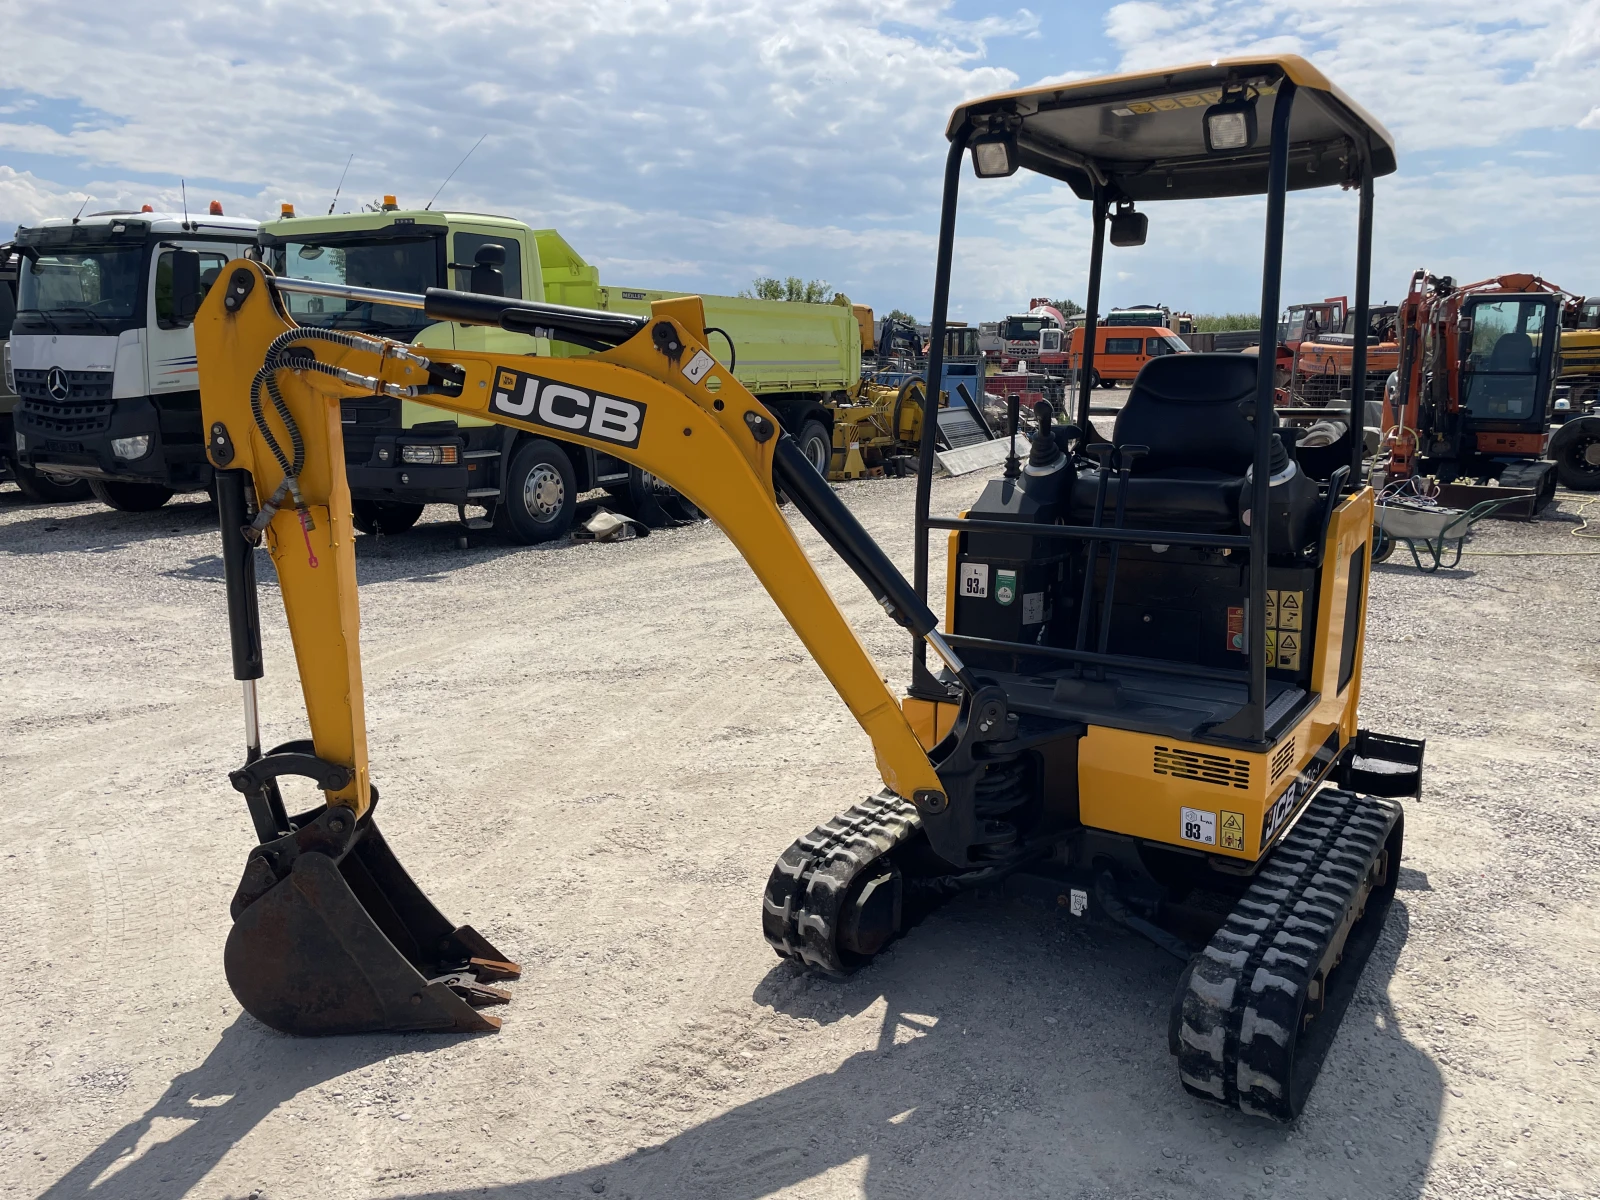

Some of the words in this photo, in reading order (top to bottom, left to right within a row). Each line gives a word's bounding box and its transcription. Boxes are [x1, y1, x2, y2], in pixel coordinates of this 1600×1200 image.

[495, 378, 641, 442] JCB
[966, 577, 980, 594] 93
[1265, 783, 1297, 840] JCB
[1185, 822, 1201, 840] 93
